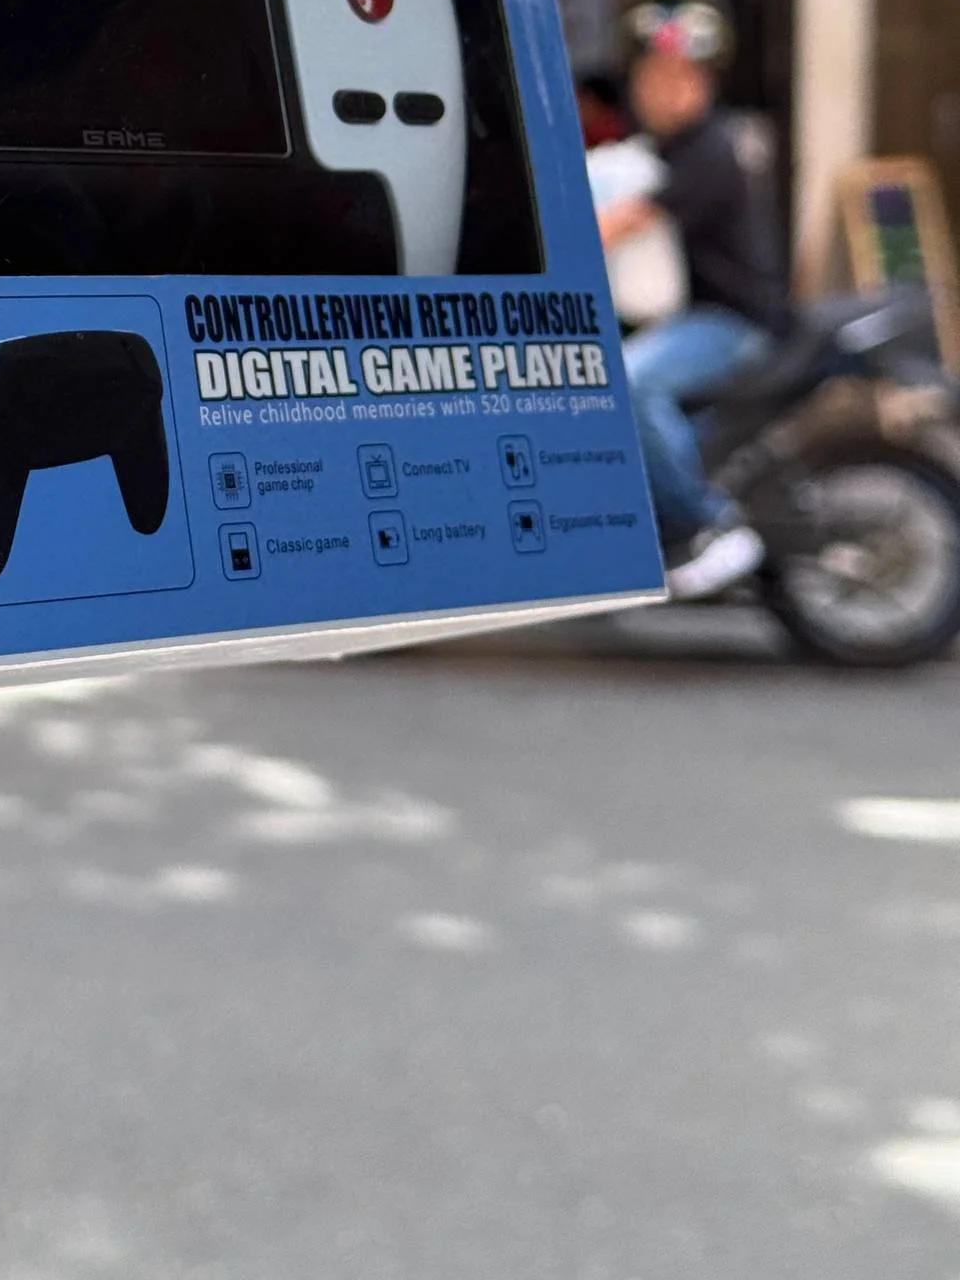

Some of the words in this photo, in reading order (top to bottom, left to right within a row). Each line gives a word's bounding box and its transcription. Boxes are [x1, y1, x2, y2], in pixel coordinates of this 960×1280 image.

[81, 129, 167, 148] GAME
[184, 292, 414, 343] CONTROLLERVIEW
[415, 291, 498, 338] RETRO
[500, 290, 600, 337] CONSOLE
[194, 346, 359, 402] DIGITAL
[359, 343, 477, 397] GAME
[478, 340, 610, 389] PLAYER
[198, 404, 253, 426] Relive
[258, 400, 347, 424] childhood
[351, 397, 436, 419] memories
[440, 395, 477, 416] with
[481, 394, 511, 414] 520
[515, 391, 566, 413] calssic
[568, 393, 616, 416] games
[254, 458, 324, 476] Professional
[402, 460, 454, 477] Connect
[453, 458, 471, 474] TV
[257, 480, 290, 496] game
[290, 476, 315, 493] chip
[411, 525, 444, 543] Long
[444, 522, 486, 541] battery
[265, 537, 315, 555] Classic
[314, 535, 350, 554] game
